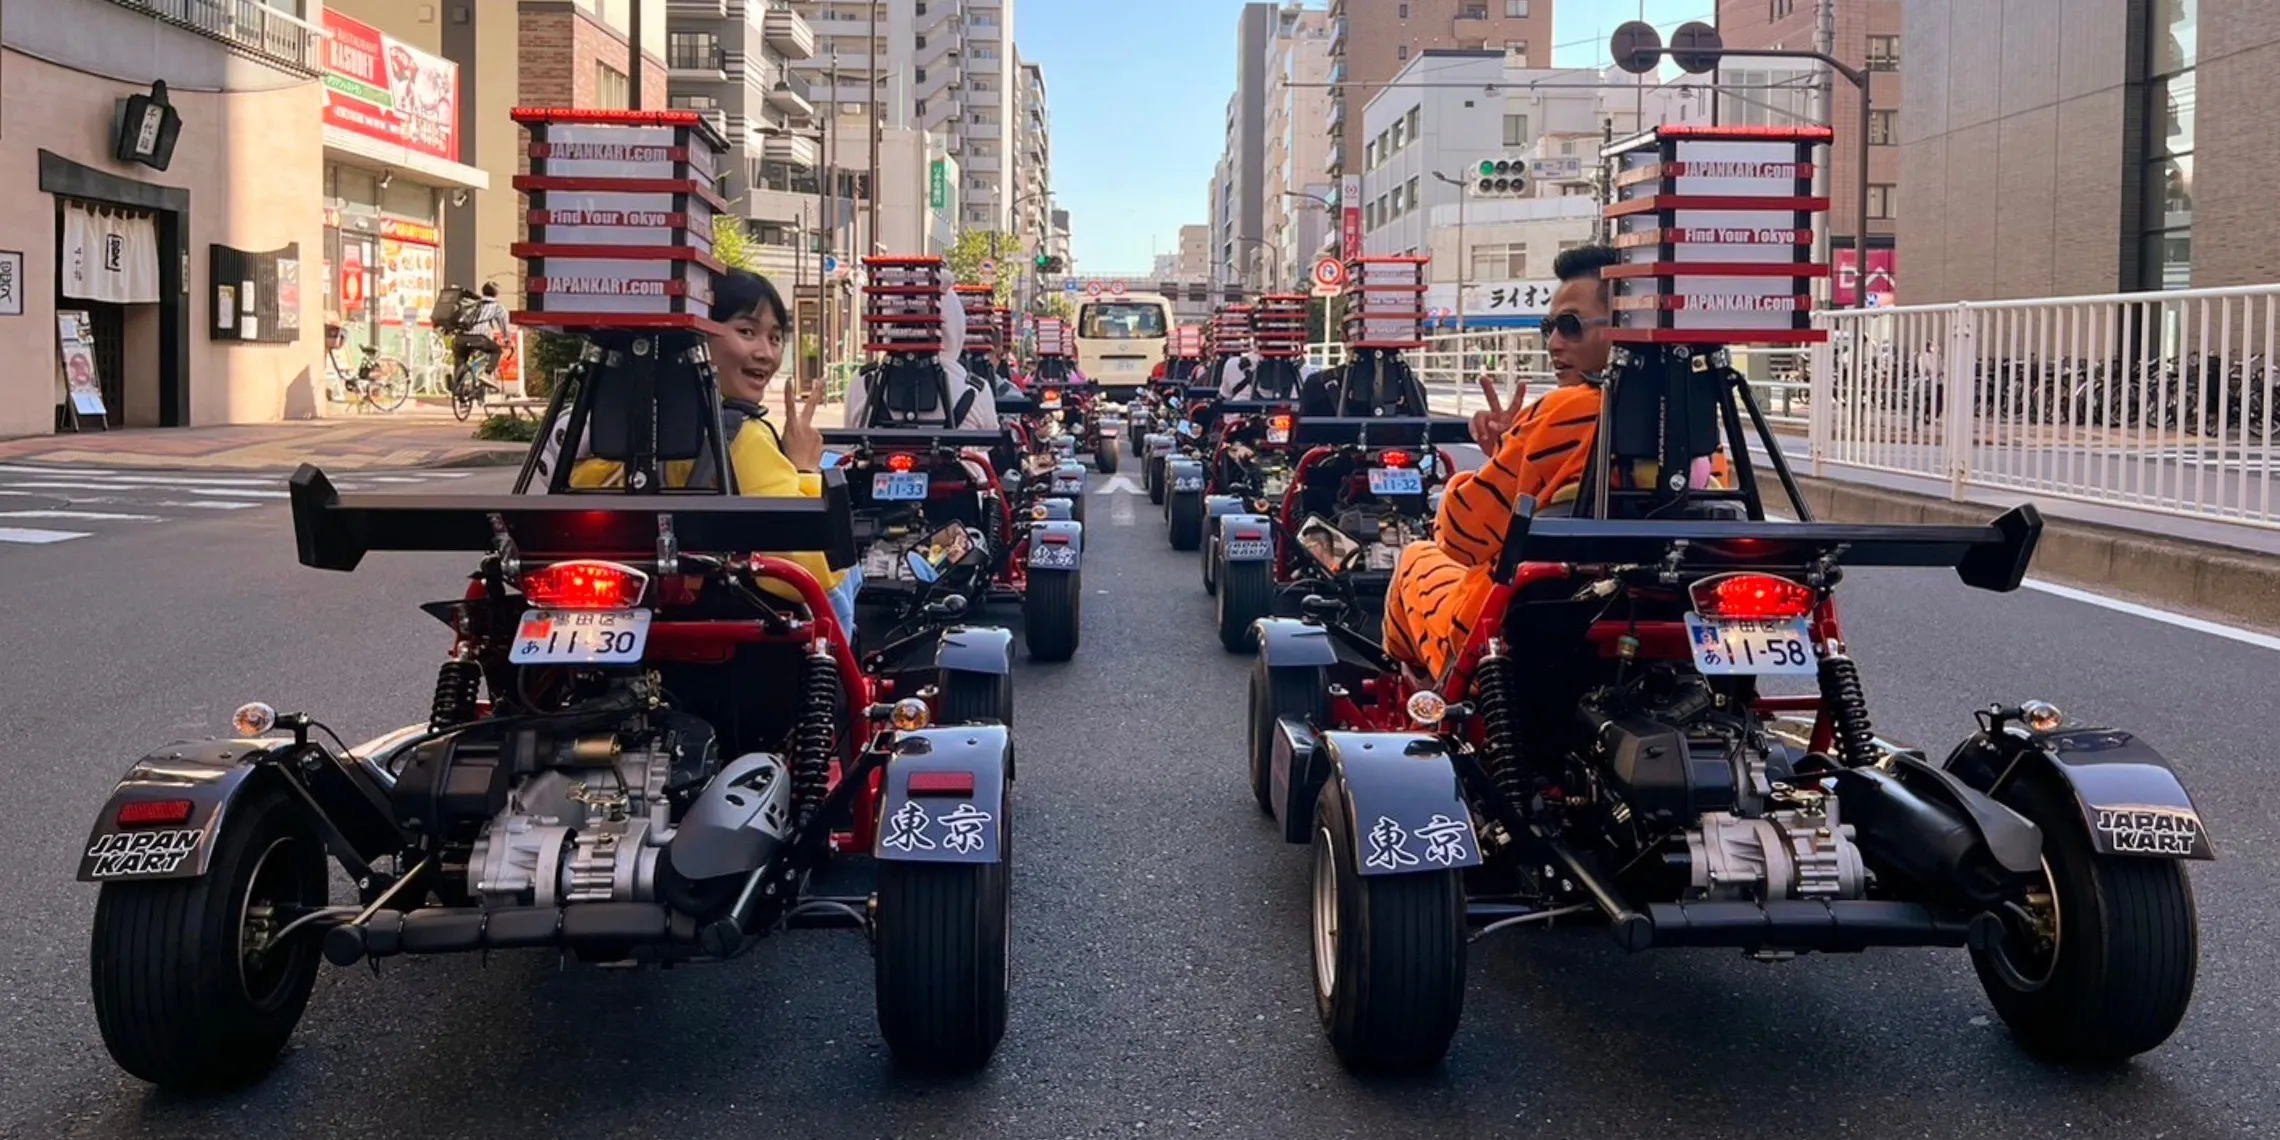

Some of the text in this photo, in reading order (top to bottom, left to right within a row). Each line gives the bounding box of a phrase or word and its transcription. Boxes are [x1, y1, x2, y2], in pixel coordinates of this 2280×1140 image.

[549, 143, 668, 162] JAPANKART.com
[1684, 162, 1795, 178] JAPANKART.com
[550, 210, 666, 227] Find Your Tokyo
[1685, 229, 1795, 244] Find Your Tokyo
[546, 278, 664, 295] JAPANKART.com
[1683, 295, 1795, 311] JAPANKART.com
[887, 483, 924, 496] 11-33
[1384, 479, 1418, 490] 11-32
[521, 641, 539, 655] あ
[1705, 639, 1806, 666] あ 11-58
[882, 800, 992, 854] 東京
[2097, 811, 2197, 835] JAPAN
[88, 830, 204, 857] JAPAN
[1365, 814, 1468, 870] 東京
[2113, 830, 2195, 854] KART
[92, 850, 189, 876] KART
